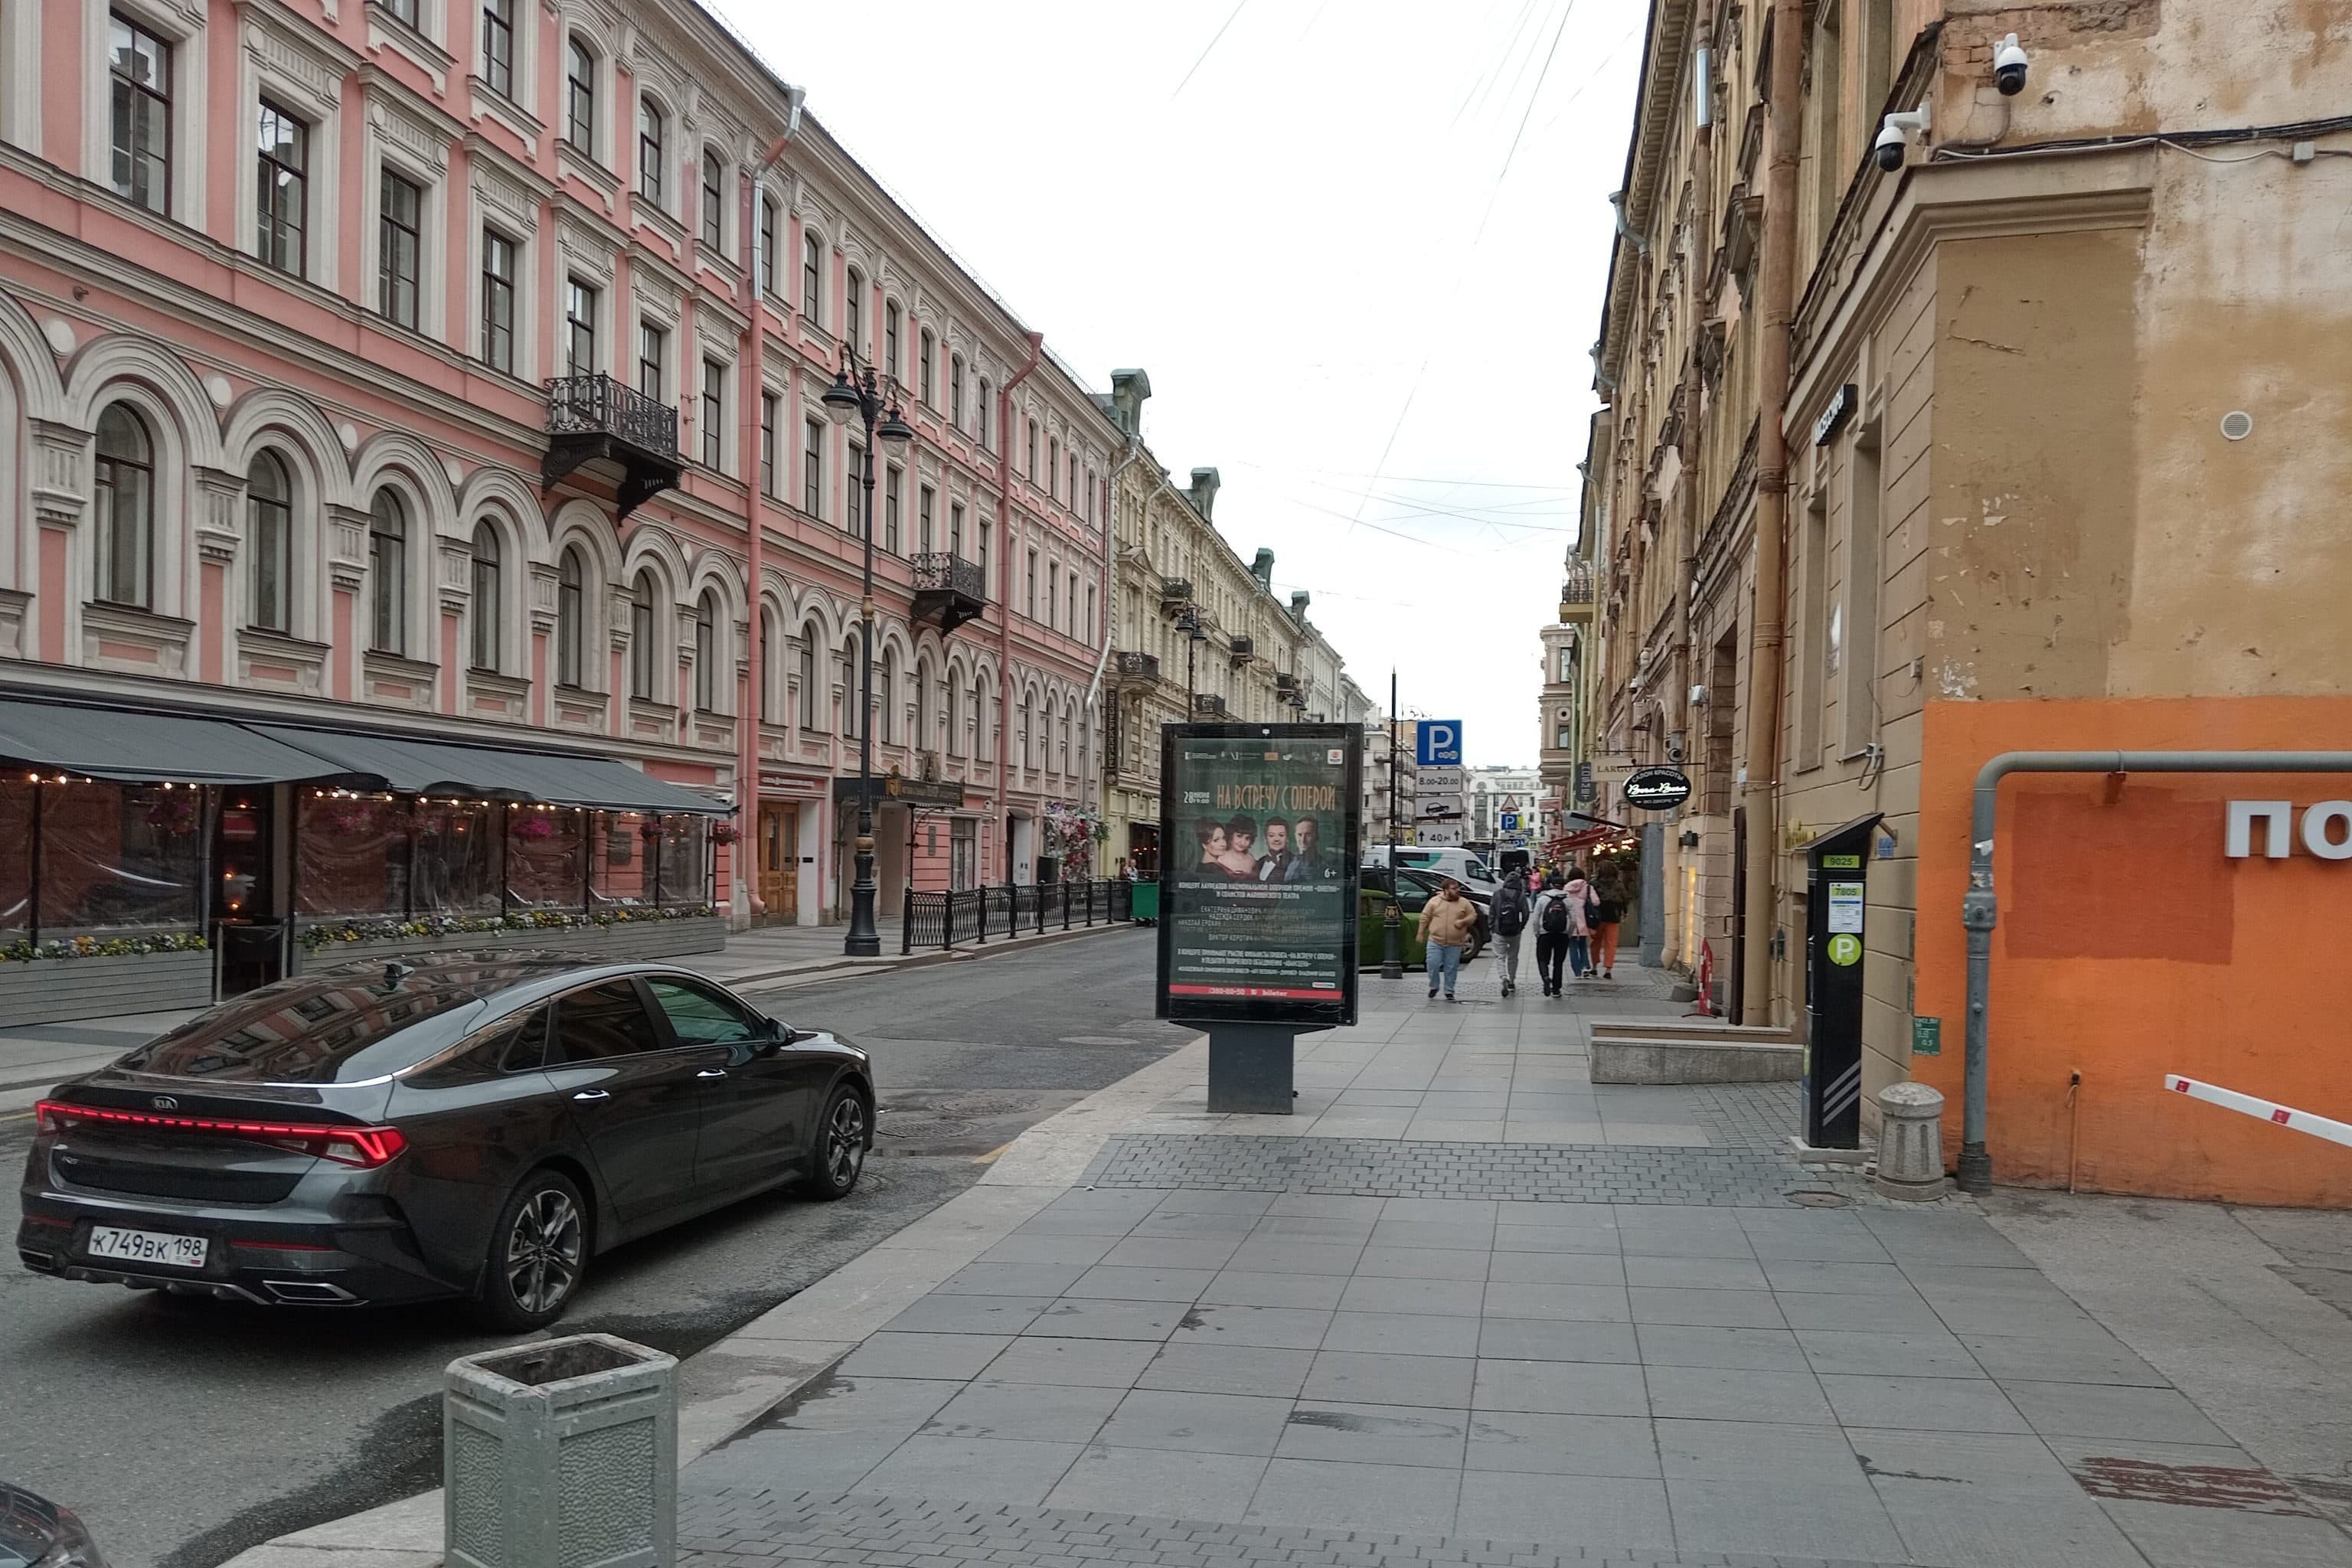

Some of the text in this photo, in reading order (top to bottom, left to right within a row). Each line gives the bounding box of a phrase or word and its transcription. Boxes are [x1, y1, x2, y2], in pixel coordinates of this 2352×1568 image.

[1429, 725, 1454, 761] P
[1632, 769, 1684, 782] САЛОН КРАСОТЫ
[1217, 784, 1231, 808] НА
[1234, 785, 1279, 809] ВСТРЕЧУ
[1291, 782, 1336, 811] ОПЕРОЙ
[2226, 800, 2352, 860] ПО
[1324, 868, 1337, 878] 6+
[1836, 938, 1854, 959] P
[92, 1230, 201, 1260] К749ВК 198
